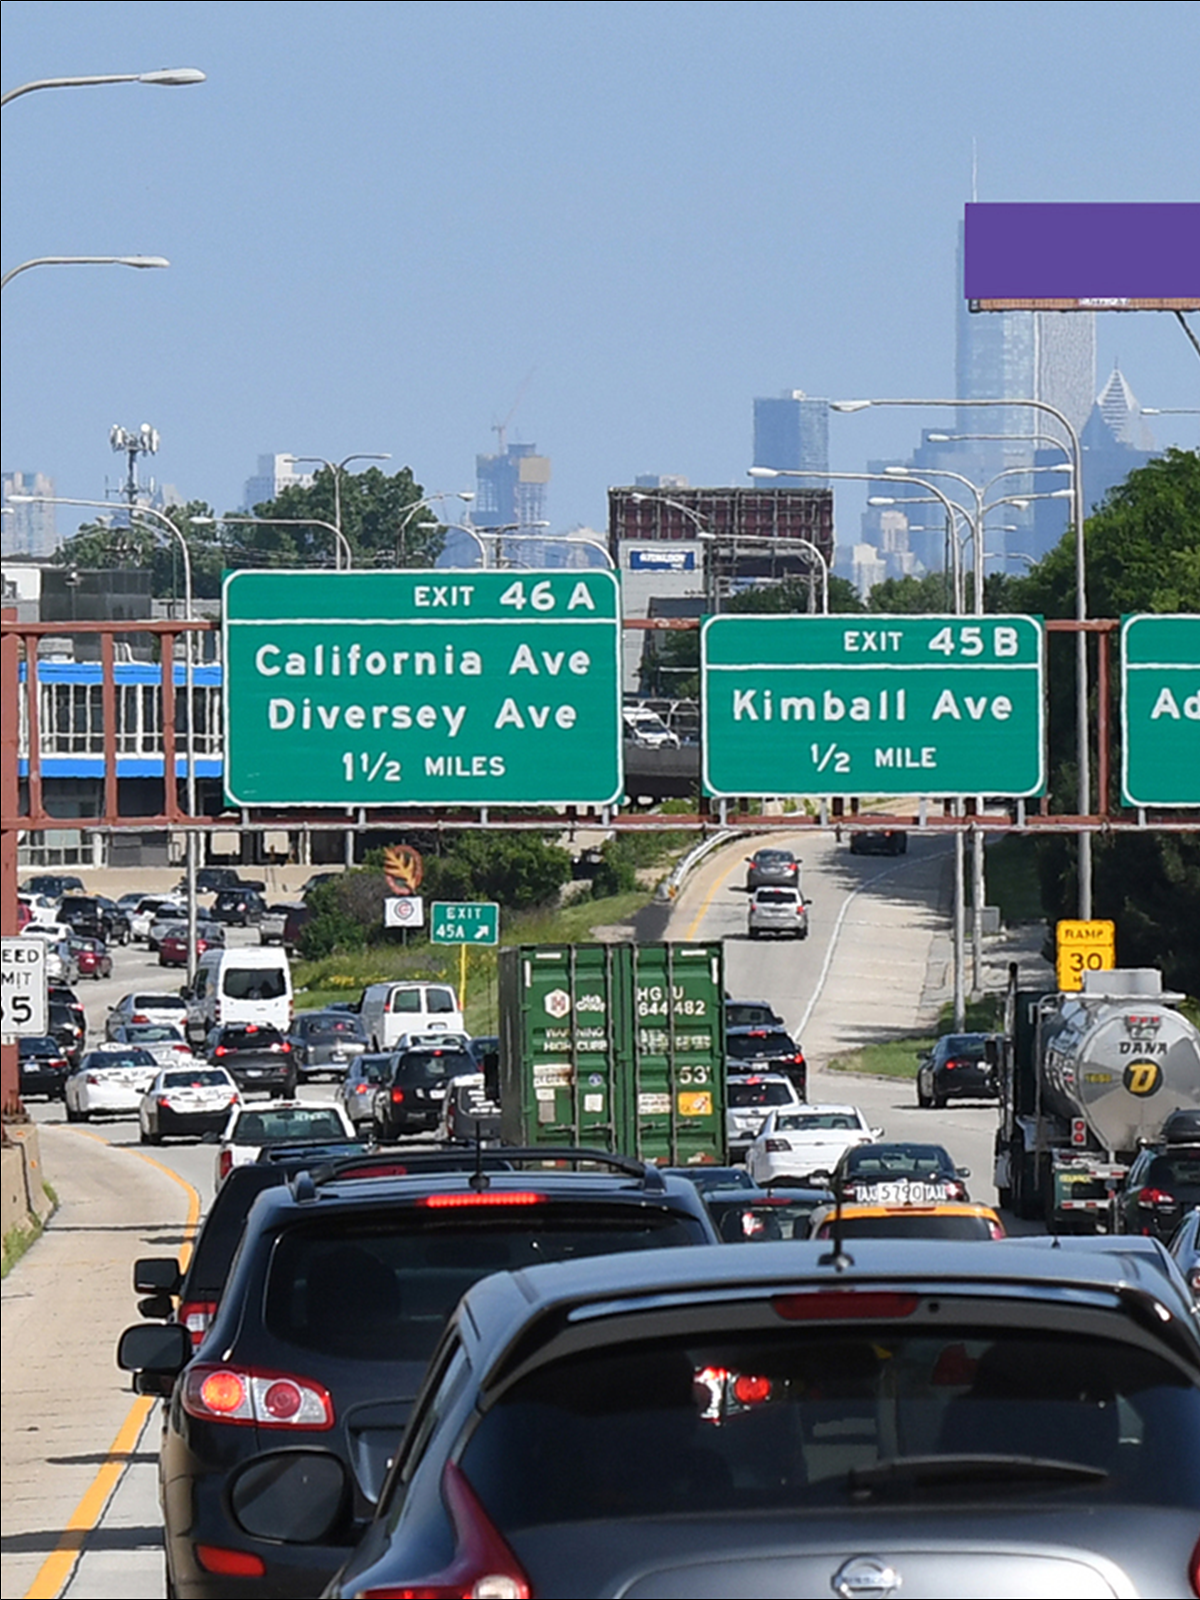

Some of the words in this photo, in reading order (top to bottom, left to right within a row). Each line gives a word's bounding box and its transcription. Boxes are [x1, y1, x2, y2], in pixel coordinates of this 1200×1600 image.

[414, 585, 474, 607] EXIT
[499, 581, 556, 611] 46
[567, 582, 596, 610] A
[843, 630, 903, 652] EXIT
[928, 627, 985, 656] 45
[993, 627, 1019, 657] B
[255, 644, 482, 676] California
[509, 644, 591, 675] Ave
[732, 689, 906, 722] Kimball
[931, 689, 1013, 721] Ave
[268, 698, 467, 737] Diversey
[494, 698, 577, 729] Ave
[424, 755, 506, 777] MILES
[874, 747, 937, 768] MILE
[445, 906, 483, 919] EXIT
[435, 924, 465, 939] 45A
[1064, 929, 1104, 940] RAMP
[2, 949, 40, 963] EED
[1069, 952, 1104, 971] 30
[2, 971, 32, 987] MIT
[637, 985, 684, 1001] HGU
[1118, 1041, 1169, 1055] DANA
